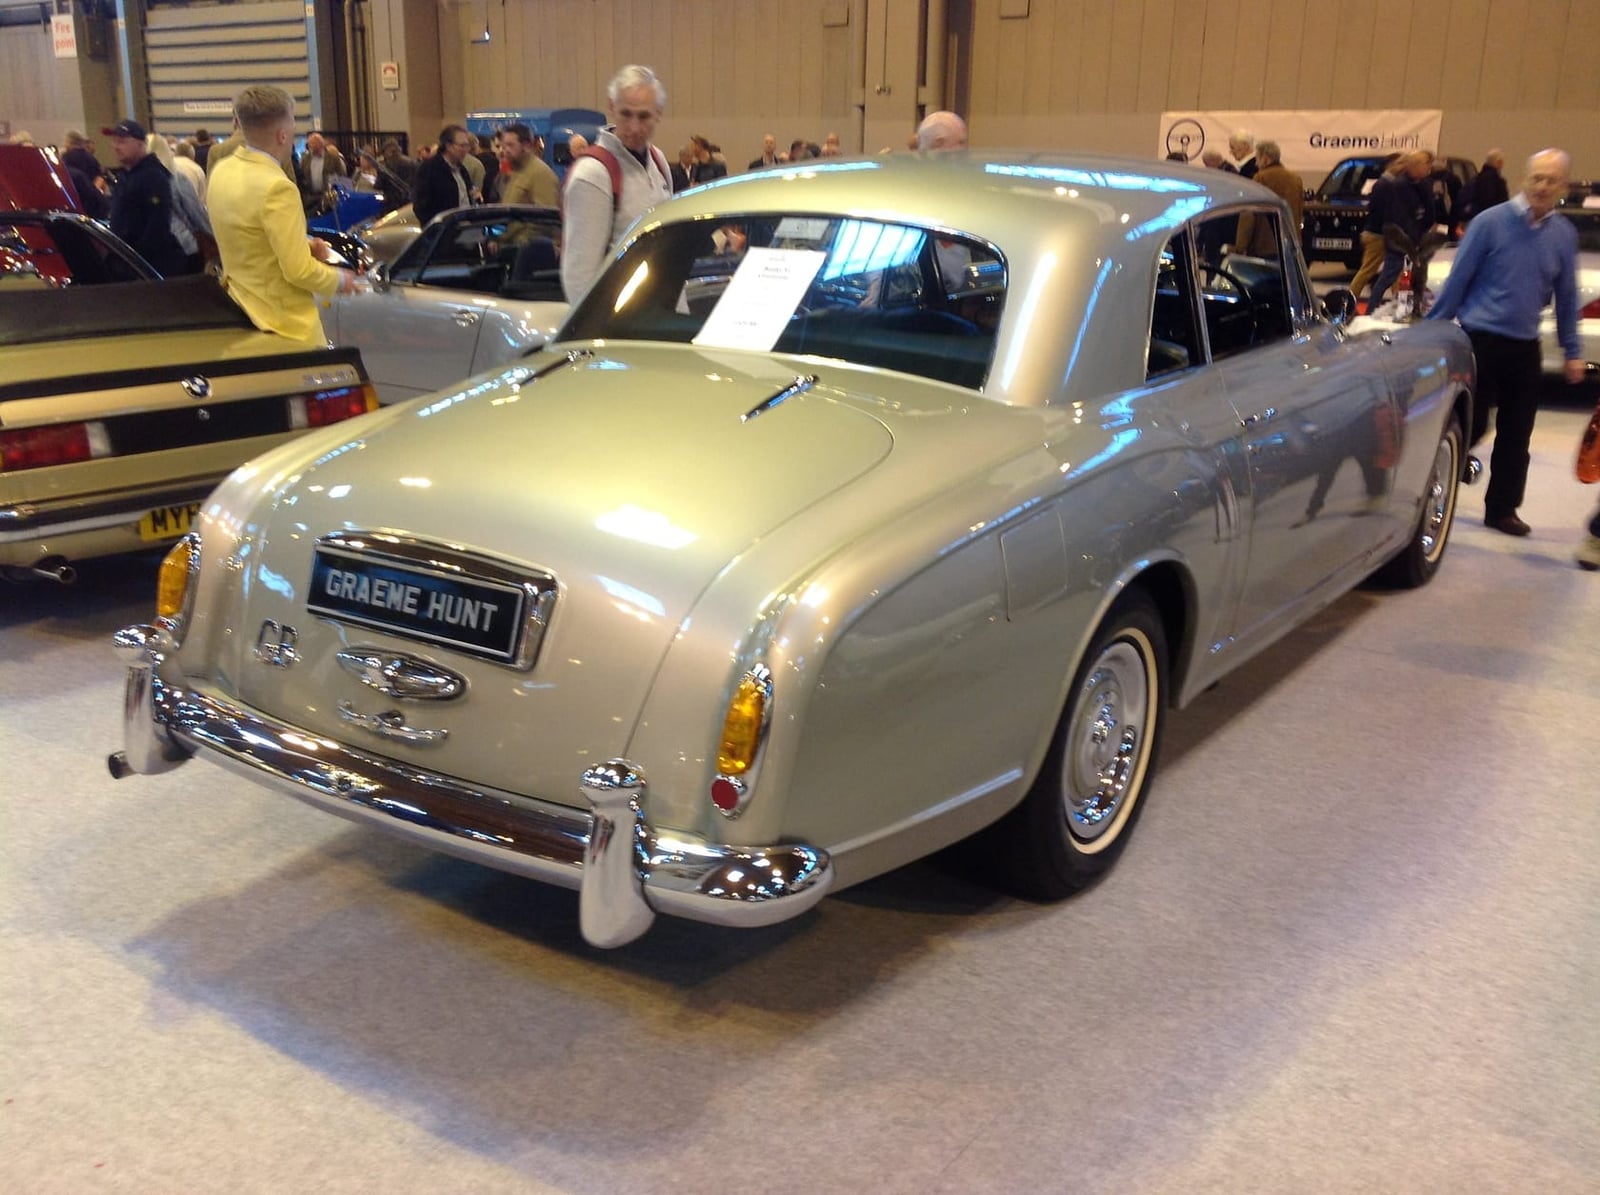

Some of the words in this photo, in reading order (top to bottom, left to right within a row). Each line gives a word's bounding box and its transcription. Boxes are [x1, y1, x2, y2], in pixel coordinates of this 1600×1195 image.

[55, 22, 71, 33] Fire
[55, 38, 75, 50] point
[324, 569, 420, 616] GRAEME
[427, 591, 499, 632] HUNT
